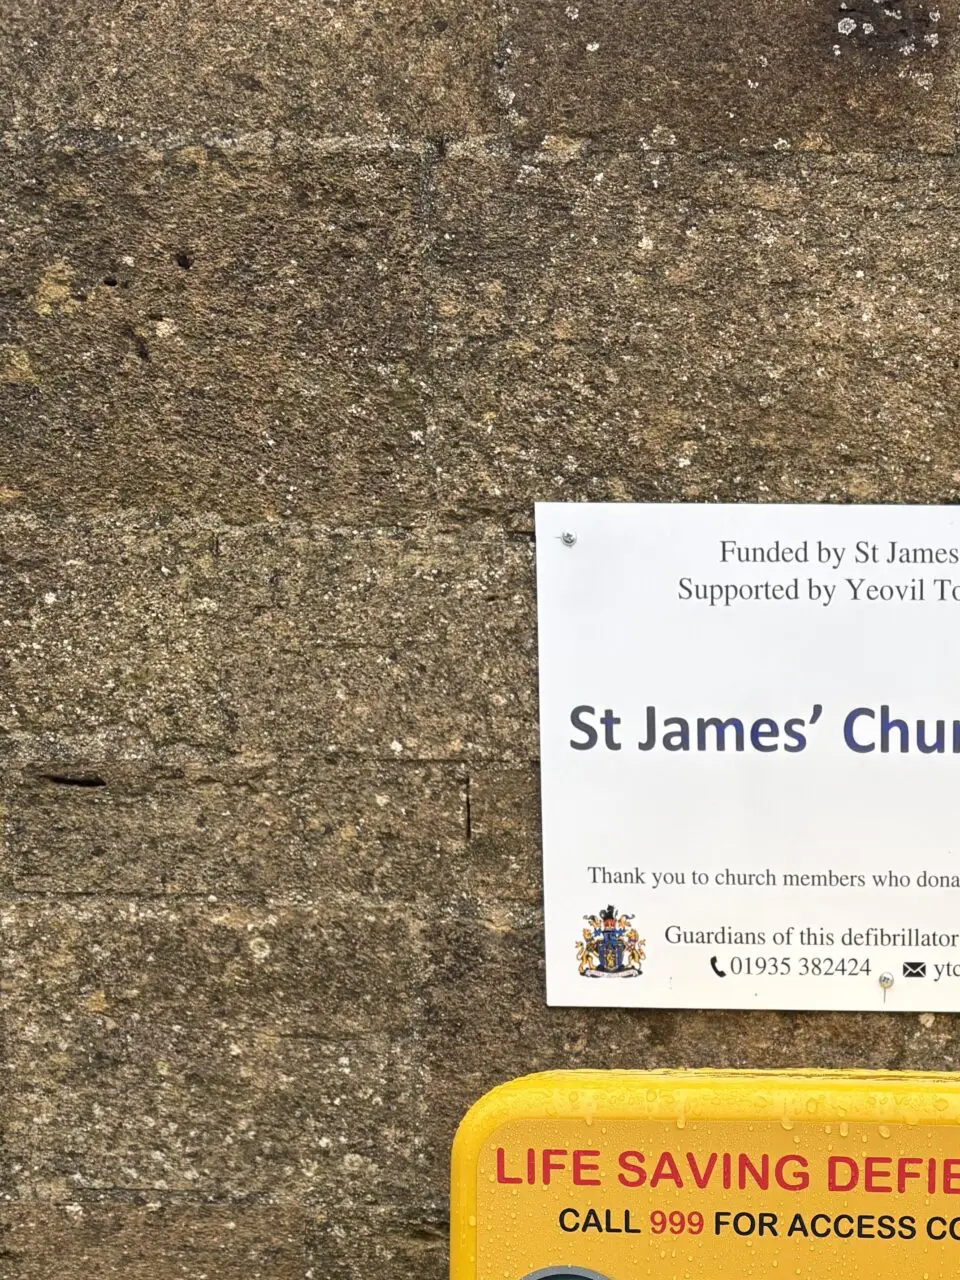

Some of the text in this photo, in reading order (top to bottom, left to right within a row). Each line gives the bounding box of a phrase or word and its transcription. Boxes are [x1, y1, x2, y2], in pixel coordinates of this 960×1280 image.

[719, 540, 808, 565] Funded
[817, 540, 845, 570] by
[855, 542, 880, 565] St
[887, 542, 959, 566] James
[678, 578, 799, 605] Supported
[807, 578, 836, 607] by
[844, 579, 925, 603] Yeovil
[569, 704, 621, 752] St
[588, 867, 645, 887] Thank
[651, 873, 685, 892] you
[691, 871, 710, 888] to
[714, 868, 776, 888] church
[782, 869, 866, 889] members
[873, 870, 911, 889] who
[665, 926, 767, 947] Guardians
[773, 926, 794, 947] of
[799, 926, 836, 948] this
[730, 956, 792, 977] 01935
[798, 957, 872, 978] 382424
[495, 1148, 601, 1187] LIFE
[616, 1150, 811, 1191] SAVING
[557, 1208, 641, 1234] CALL
[648, 1210, 705, 1236] 999
[713, 1210, 779, 1238] FOR
[787, 1212, 917, 1241] ACCESS
